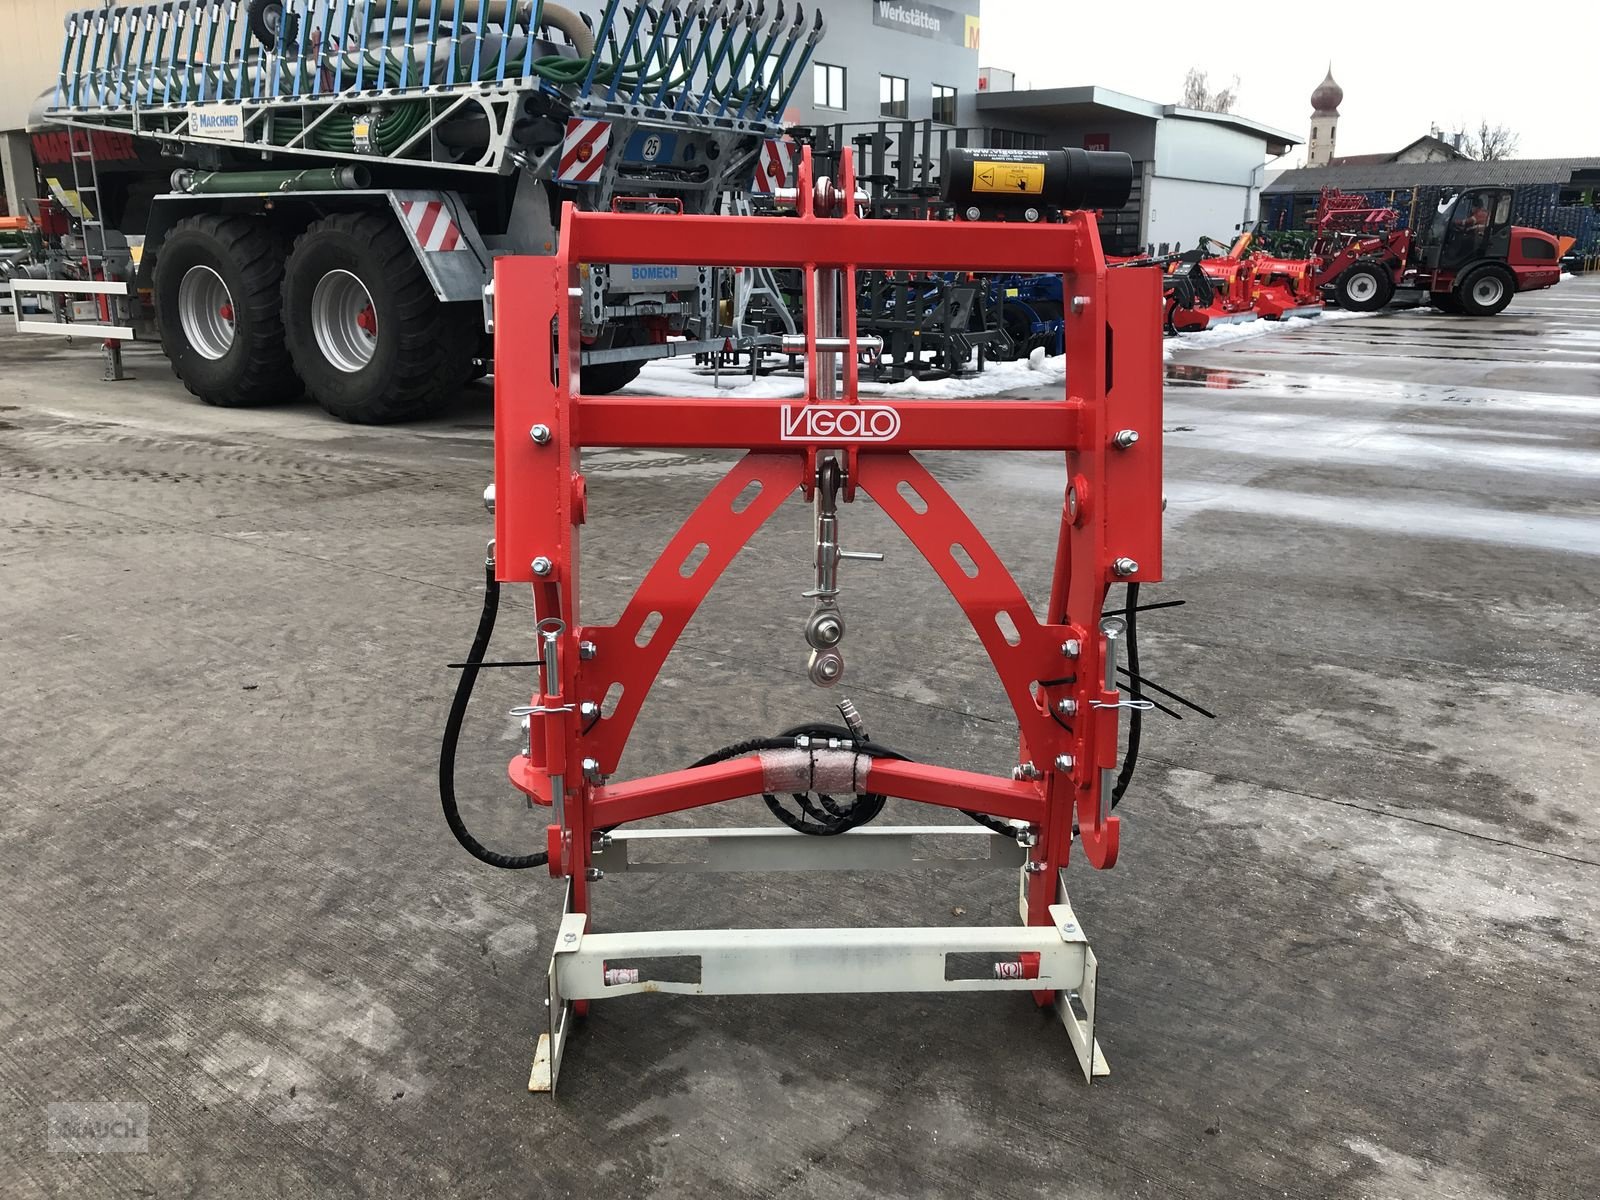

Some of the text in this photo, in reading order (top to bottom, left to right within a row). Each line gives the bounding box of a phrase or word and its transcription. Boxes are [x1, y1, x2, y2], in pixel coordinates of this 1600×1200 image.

[880, 1, 940, 31] Werkstätten
[200, 114, 238, 128] MARCHNER
[645, 140, 658, 155] 25
[963, 148, 1049, 156] www.vigolo.com
[632, 266, 677, 279] BOMECH
[781, 405, 901, 441] VIGOLO
